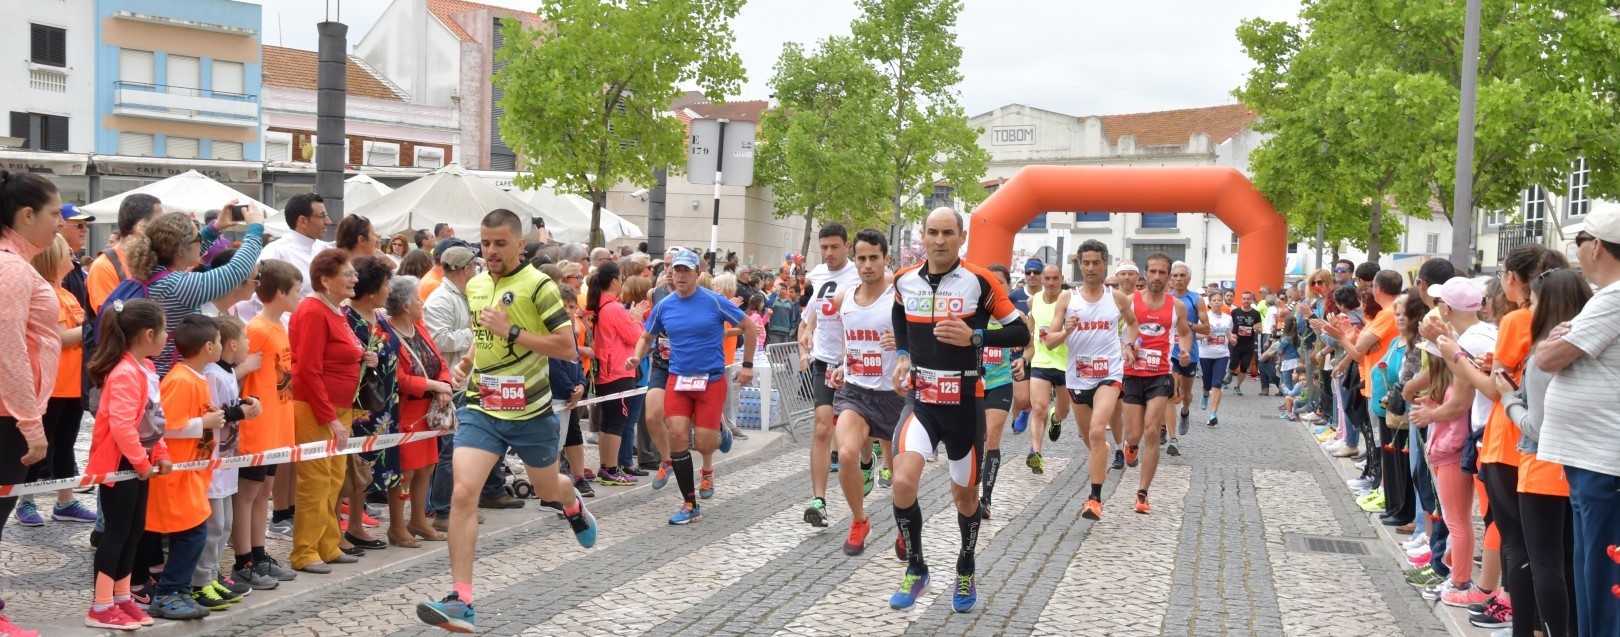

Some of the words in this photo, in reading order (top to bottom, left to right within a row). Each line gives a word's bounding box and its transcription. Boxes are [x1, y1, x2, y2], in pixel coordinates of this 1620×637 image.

[692, 135, 700, 144] E
[994, 129, 1034, 142] TOBOM
[988, 349, 1002, 358] 091
[863, 356, 882, 367] 089
[1093, 362, 1108, 371] 024
[502, 387, 525, 400] 054
[939, 381, 959, 394] 125
[966, 521, 979, 551] Kalenji
